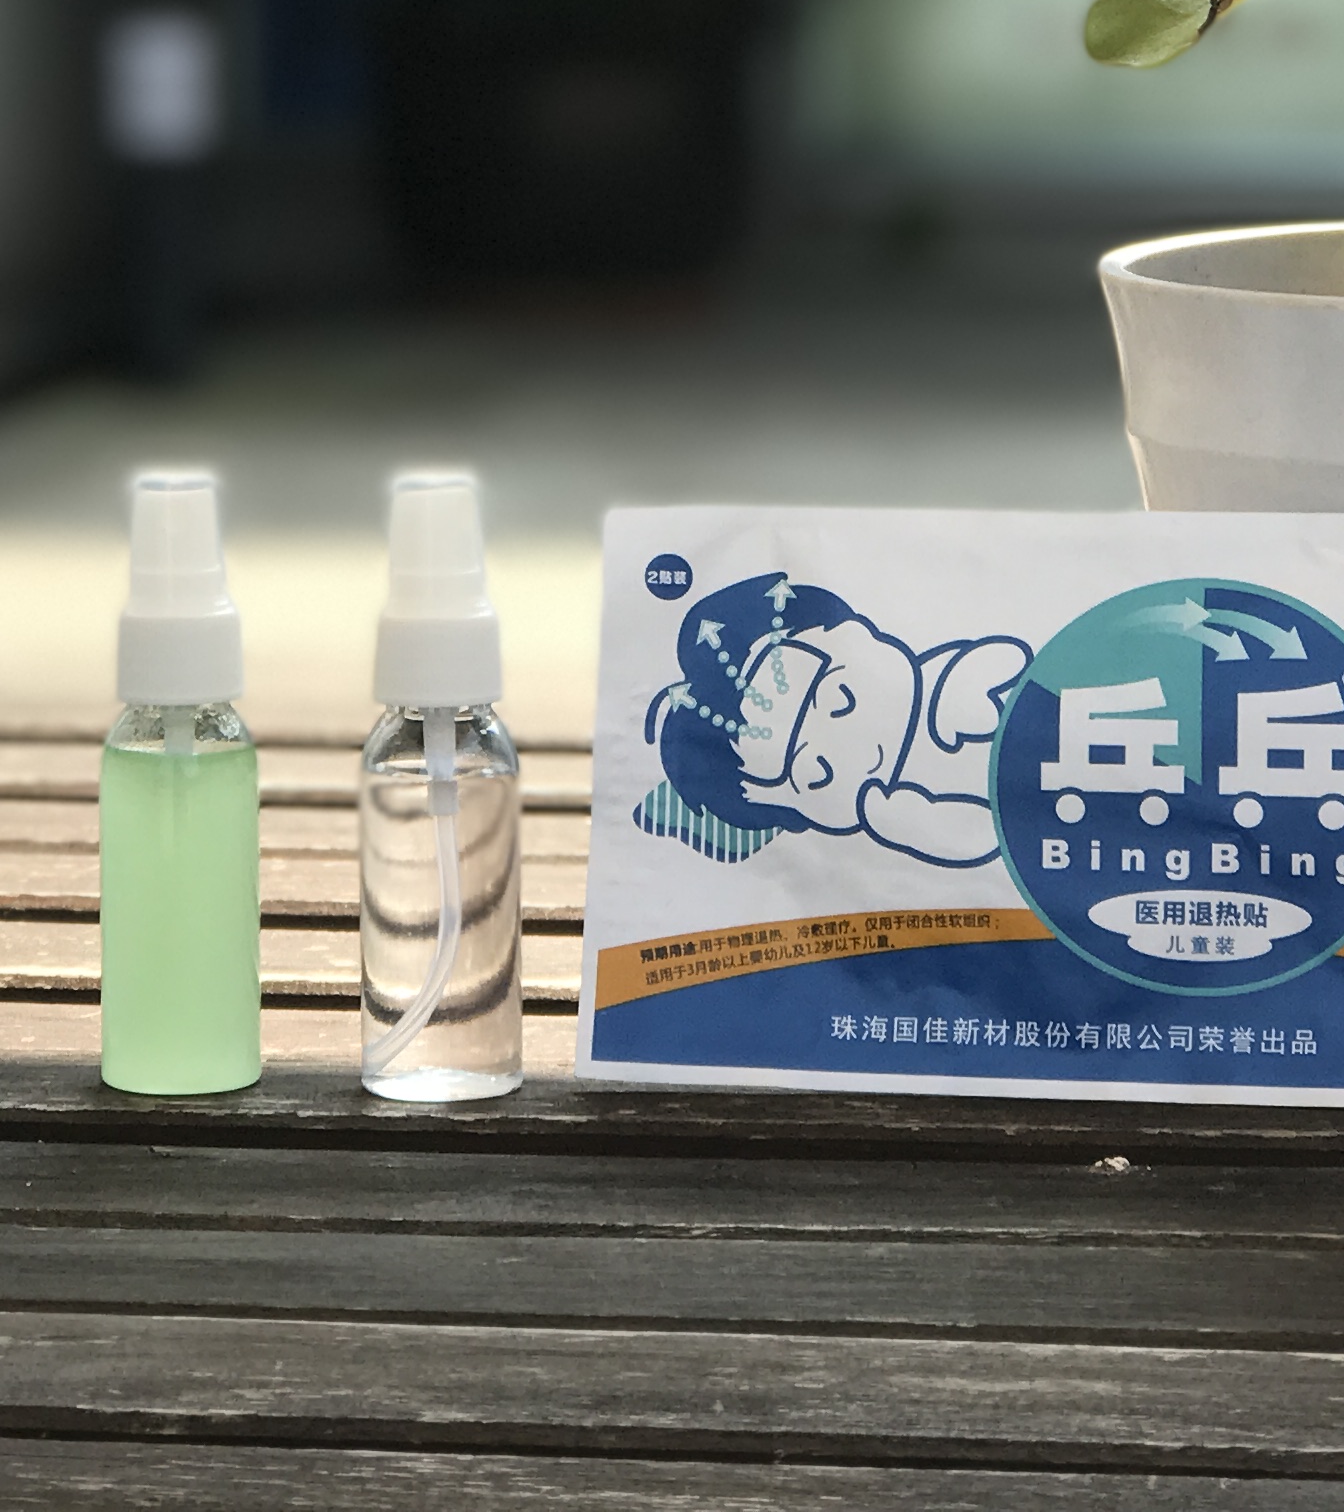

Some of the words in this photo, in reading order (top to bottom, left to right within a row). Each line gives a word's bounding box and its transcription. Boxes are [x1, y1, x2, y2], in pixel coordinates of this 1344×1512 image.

[1135, 900, 1268, 928] 医用退热贴
[1166, 935, 1235, 955] 儿童装
[831, 1015, 1318, 1055] 珠海国佳新材股份有限公司荣誉出品
